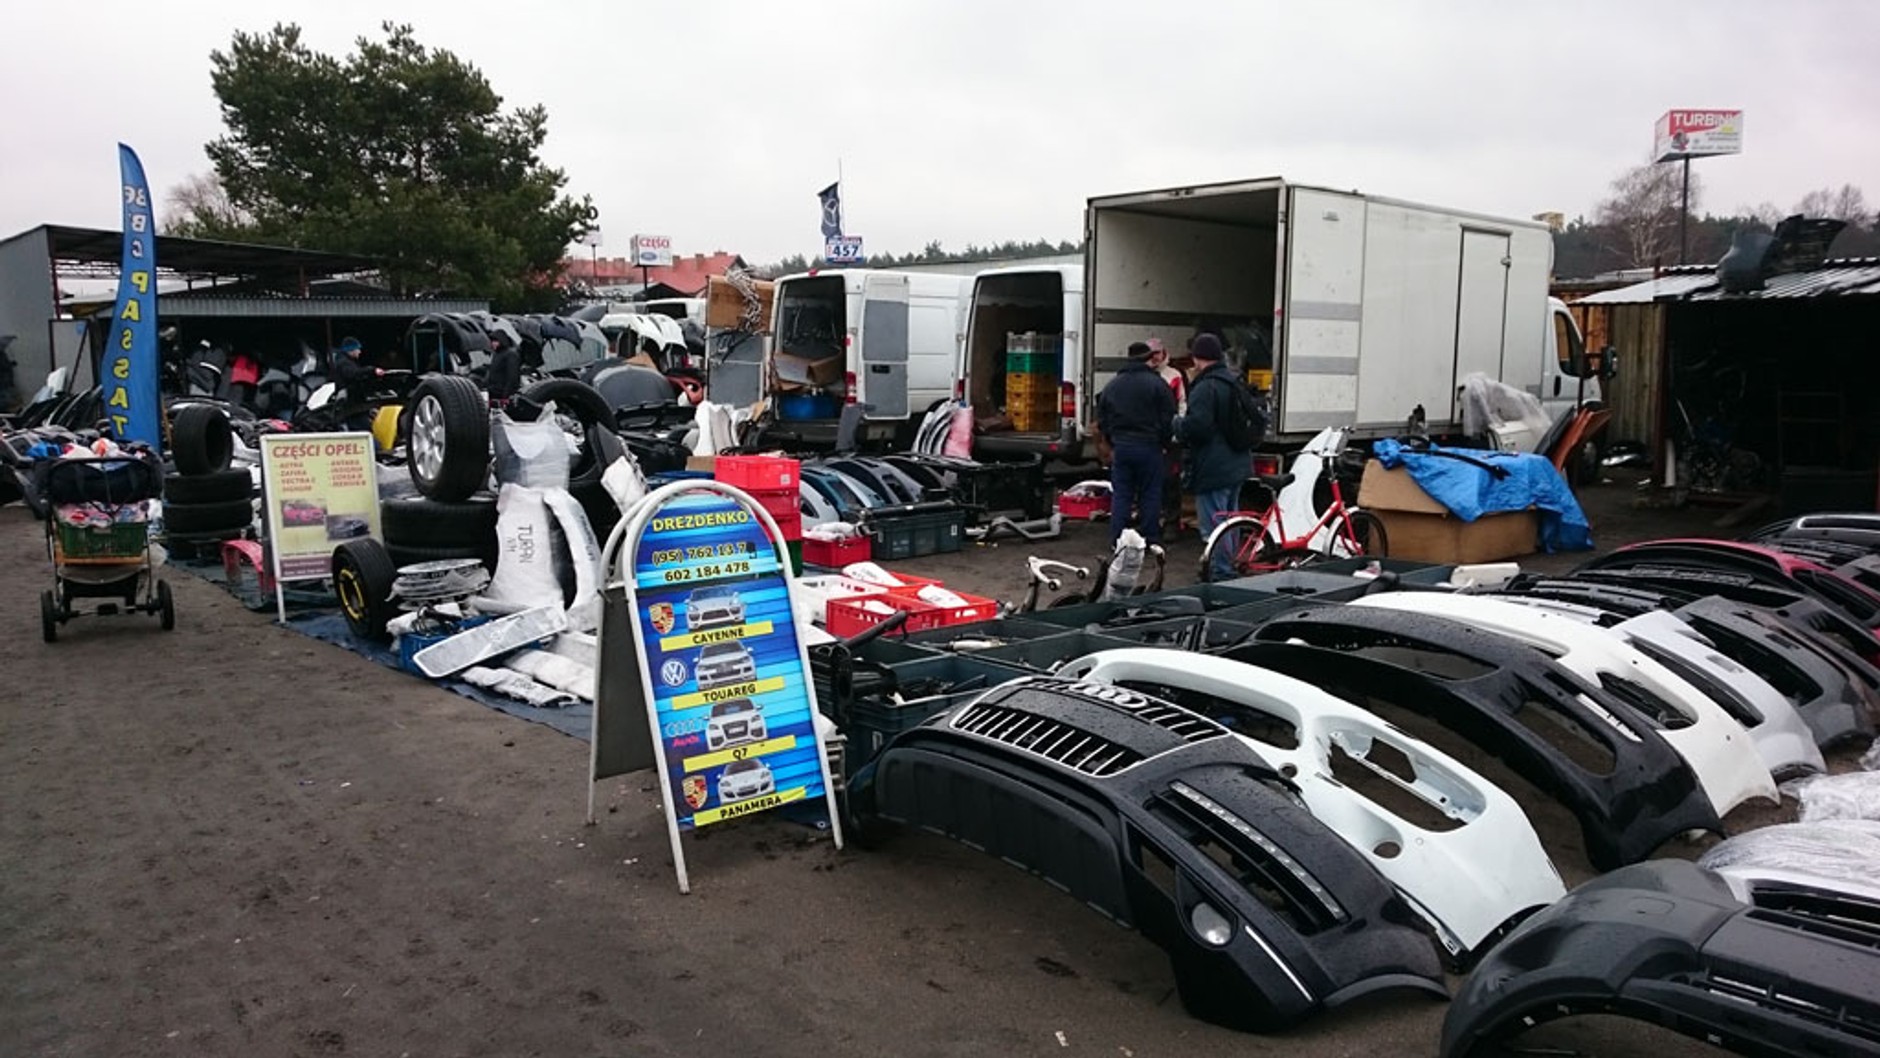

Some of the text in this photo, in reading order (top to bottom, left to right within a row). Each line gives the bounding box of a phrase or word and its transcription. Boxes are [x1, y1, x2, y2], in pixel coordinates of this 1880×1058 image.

[833, 244, 859, 257] 457
[272, 443, 365, 459] CZĘŚCI OPEL:
[652, 510, 749, 532] DREZDENKO
[652, 549, 683, 566] (95)
[687, 546, 714, 559] 762
[664, 562, 750, 581] 602 184 478
[692, 627, 745, 644] CAYENNE
[703, 684, 756, 702] TOUAREG
[732, 748, 749, 760] Q7
[720, 795, 783, 818] PANAMERA
